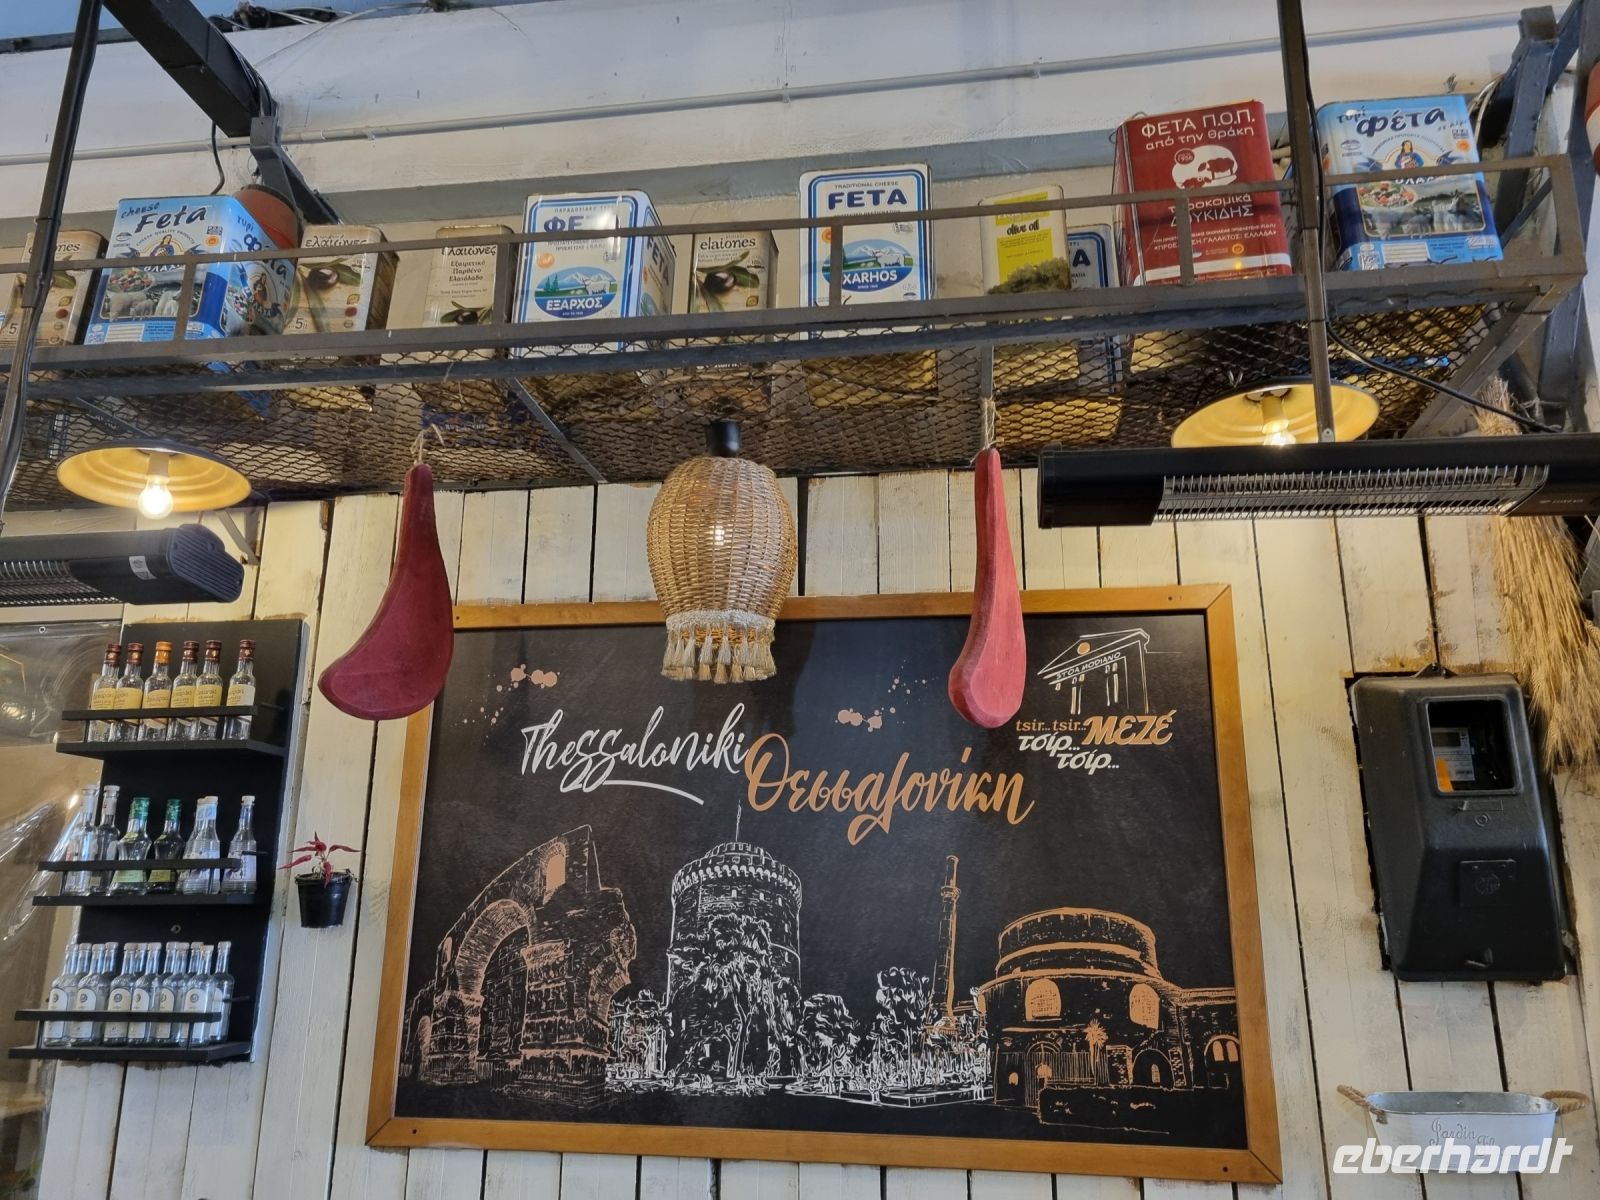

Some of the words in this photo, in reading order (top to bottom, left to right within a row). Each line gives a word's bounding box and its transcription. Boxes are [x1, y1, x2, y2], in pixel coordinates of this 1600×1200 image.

[1141, 118, 1197, 139] ΦΕΤΑ
[1202, 109, 1255, 128] Π.Ο.Π.
[1356, 107, 1447, 138] φέτα
[1145, 137, 1175, 151] από
[1178, 132, 1204, 144] την
[834, 182, 873, 190] TRADITIONAL
[828, 188, 908, 210] FETA
[121, 201, 160, 219] cheese
[134, 205, 207, 234] Feta
[1006, 223, 1027, 236] olive
[1028, 219, 1040, 231] oil
[700, 236, 757, 250] elaiones
[450, 260, 486, 268] Εξαιρετικό
[647, 235, 669, 286] FETA
[842, 269, 898, 285] XARHOS
[545, 297, 603, 311] ΕΞΑΡΧΟΣ
[9, 323, 18, 335] 5
[295, 318, 303, 330] 5
[1055, 666, 1080, 680] STOA
[1081, 651, 1121, 670] MODIANO
[520, 702, 750, 804] Thessaloniki
[744, 732, 1036, 846] Θεσσαλονίκη
[1429, 1117, 1477, 1146] Jardin
